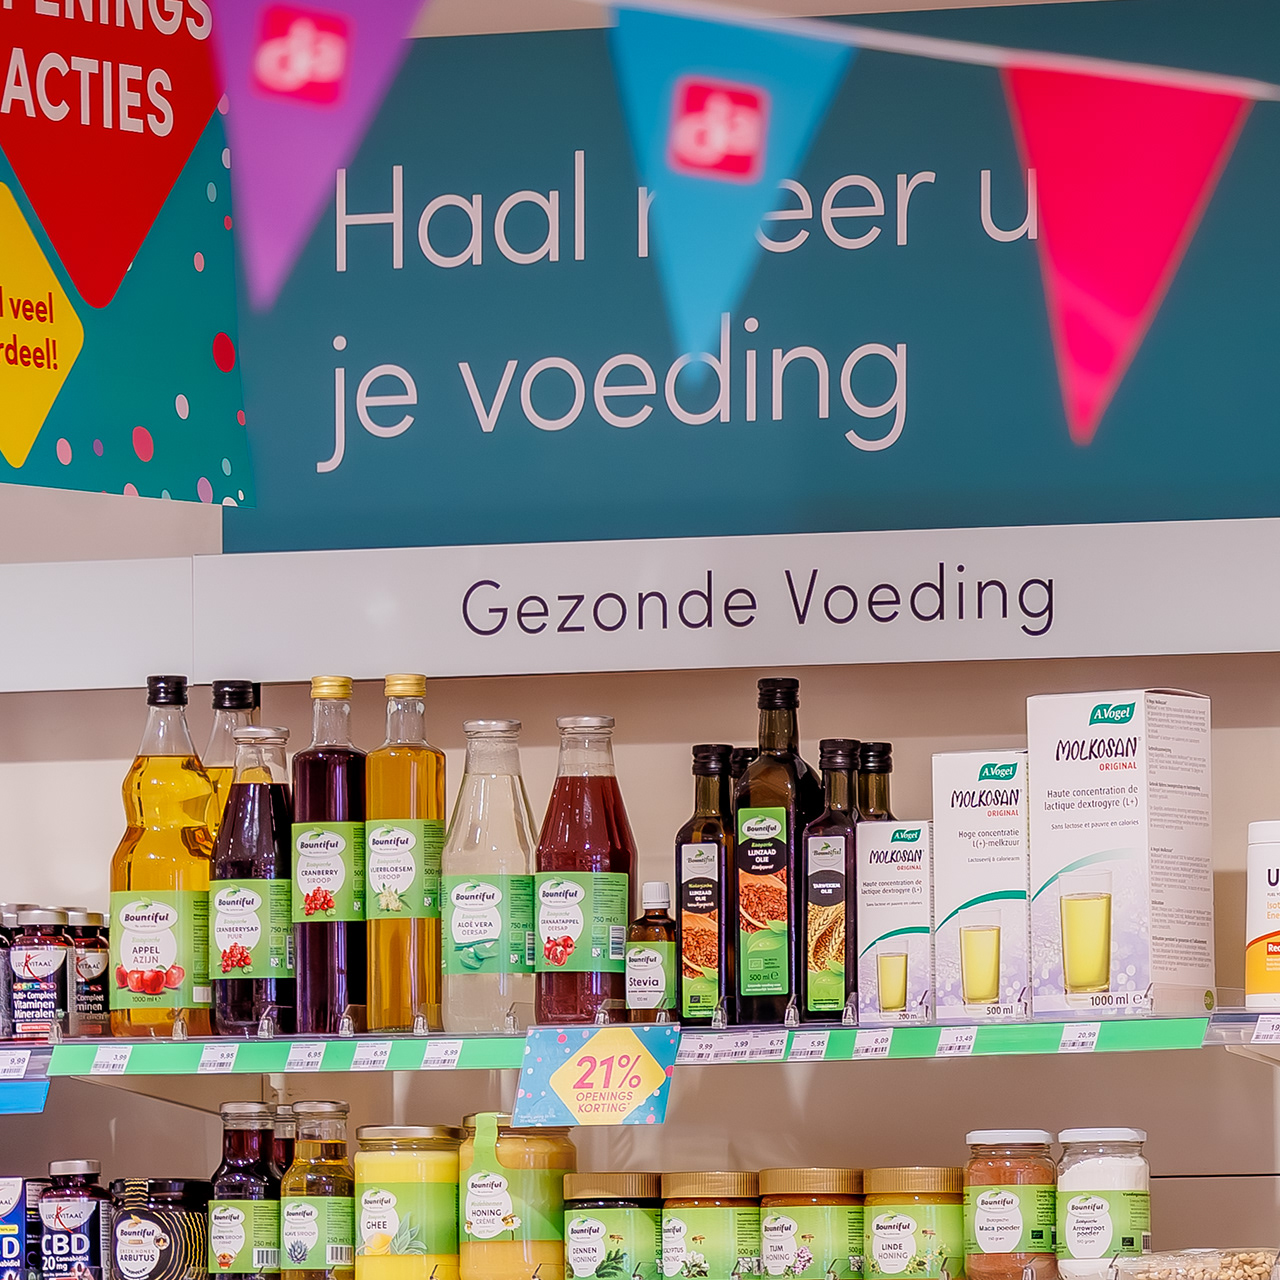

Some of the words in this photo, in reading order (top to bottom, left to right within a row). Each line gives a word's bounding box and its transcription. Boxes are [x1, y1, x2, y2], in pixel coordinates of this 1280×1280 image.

[0, 47, 174, 136] ACTIES
[335, 150, 585, 272] Haal
[9, 291, 54, 324] veel
[316, 335, 418, 473] je
[459, 311, 907, 452] voeding
[462, 569, 758, 636] Gezonde
[784, 561, 1055, 637] Voeding
[1094, 706, 1131, 721] A.Vogel
[1055, 737, 1138, 762] MOLKOSAN
[1099, 762, 1137, 772] ORIGINAL
[951, 789, 1019, 808] MOLKOSAN
[455, 891, 495, 902] Bountiful
[542, 889, 577, 900] Bountiful
[124, 912, 169, 923] Bountiful
[629, 976, 659, 987] Stevia
[14, 1000, 55, 1009] Vitaminen
[1090, 993, 1113, 1006] 1000
[1115, 994, 1129, 1005] ml
[14, 1010, 55, 1019] Mineralen
[986, 1006, 1001, 1015] 500
[1002, 1005, 1013, 1014] ml
[573, 1055, 642, 1089] 21%
[576, 1091, 634, 1104] OPENINGS
[471, 1208, 501, 1218] HONING
[366, 1220, 387, 1230] GHEE
[41, 1234, 90, 1254] CBD
